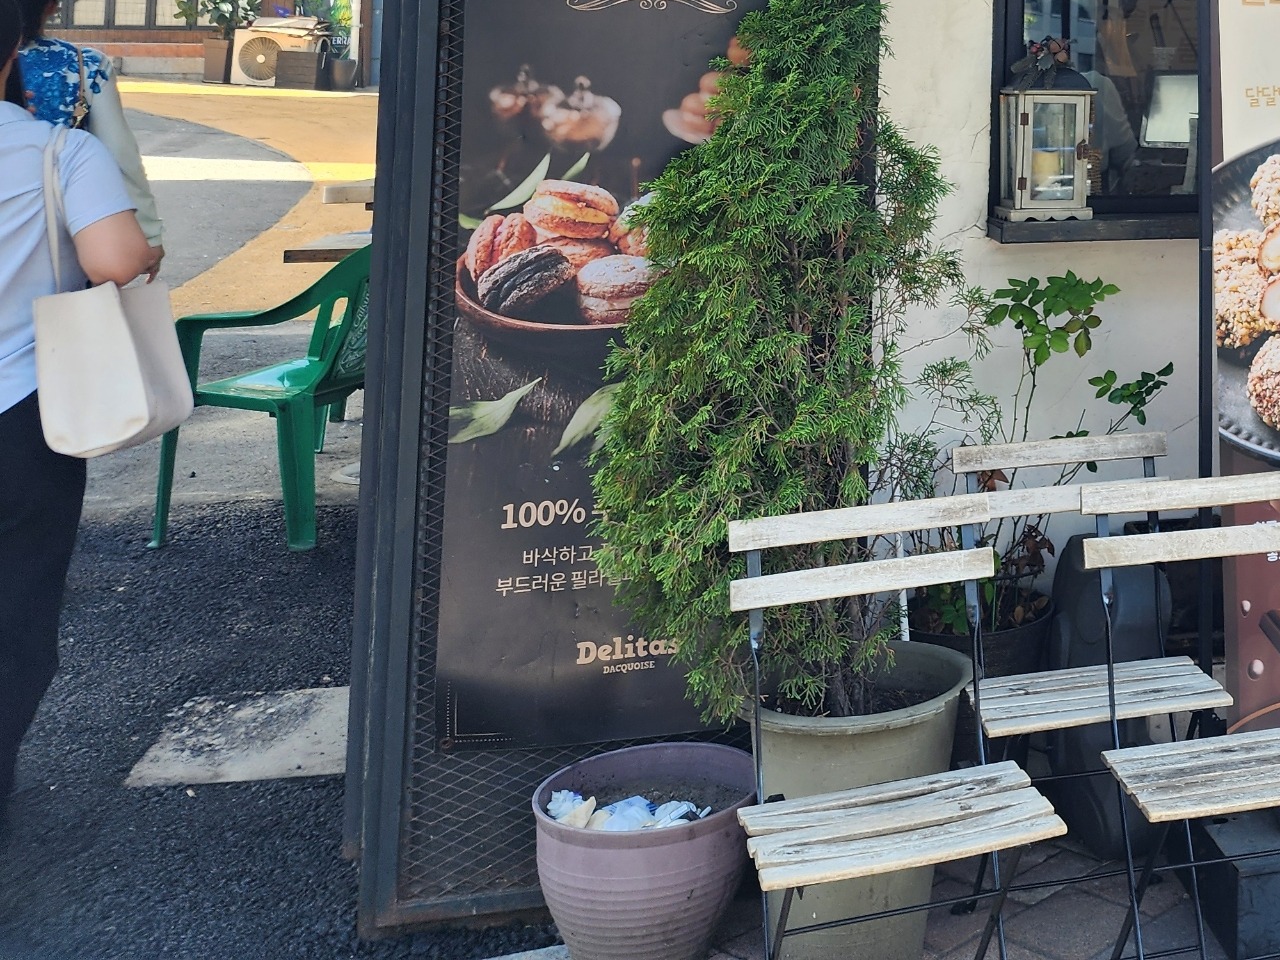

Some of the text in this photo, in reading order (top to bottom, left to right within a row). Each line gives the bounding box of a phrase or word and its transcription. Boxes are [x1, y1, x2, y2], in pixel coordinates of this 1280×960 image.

[332, 36, 351, 45] ERRA
[501, 499, 586, 529] 100%
[522, 544, 595, 567] 바삭하고
[496, 573, 567, 597] 부드러운
[576, 634, 679, 665] Delitas
[602, 660, 655, 675] DACQUOISE
